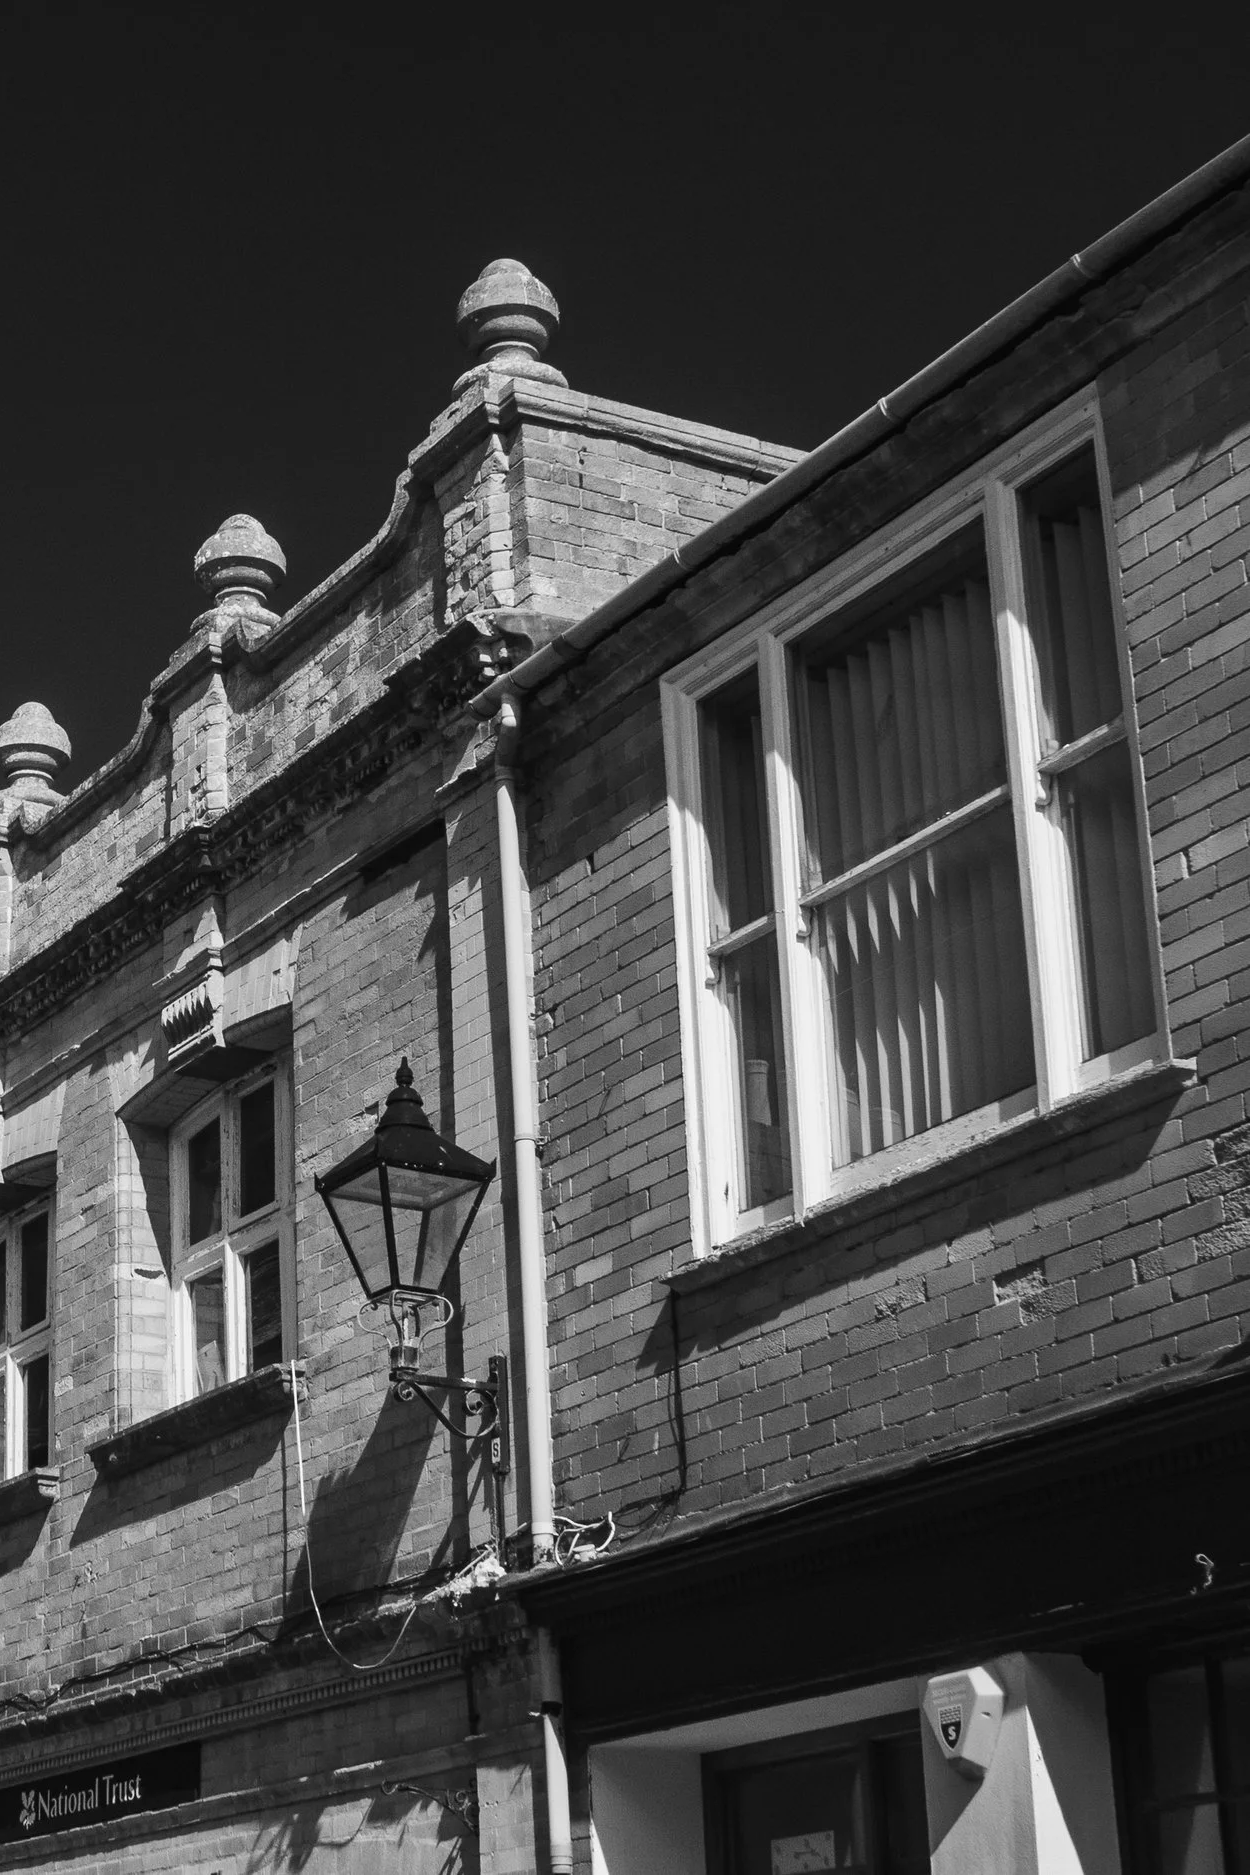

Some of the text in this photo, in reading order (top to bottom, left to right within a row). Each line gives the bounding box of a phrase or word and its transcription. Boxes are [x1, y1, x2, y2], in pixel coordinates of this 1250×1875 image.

[948, 1726, 957, 1740] S
[38, 1774, 141, 1820] National Trust
